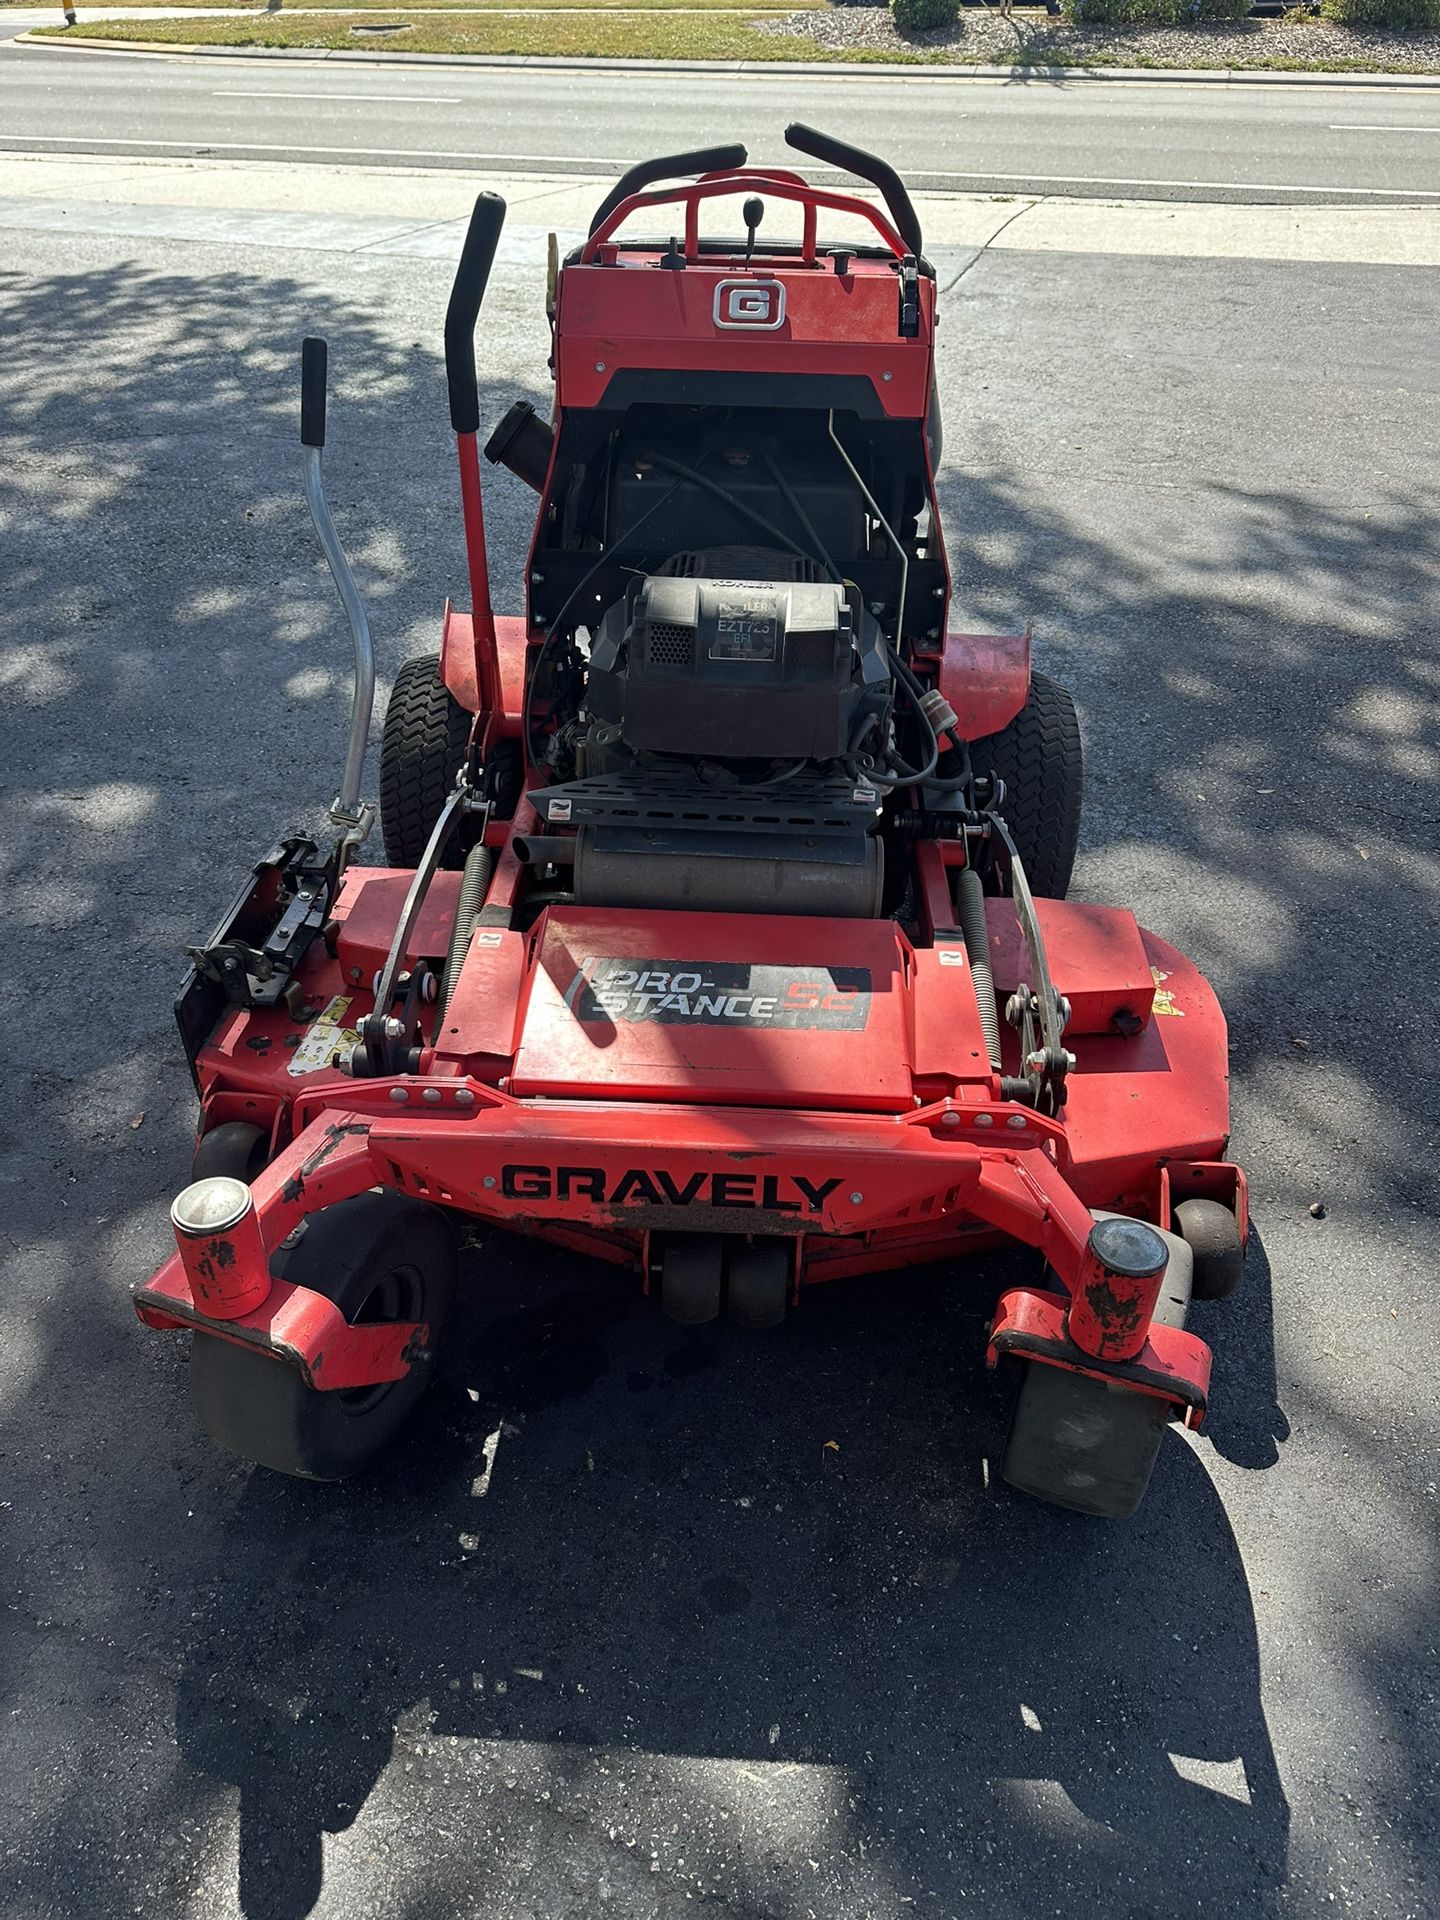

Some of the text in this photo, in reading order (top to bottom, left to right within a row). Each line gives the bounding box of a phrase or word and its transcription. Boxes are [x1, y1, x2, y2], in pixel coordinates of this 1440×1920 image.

[729, 289, 770, 320] G
[734, 633, 751, 644] EFI
[601, 970, 716, 994] PRO-
[591, 991, 778, 1019] STANCE
[501, 1164, 846, 1213] GRAVELY
